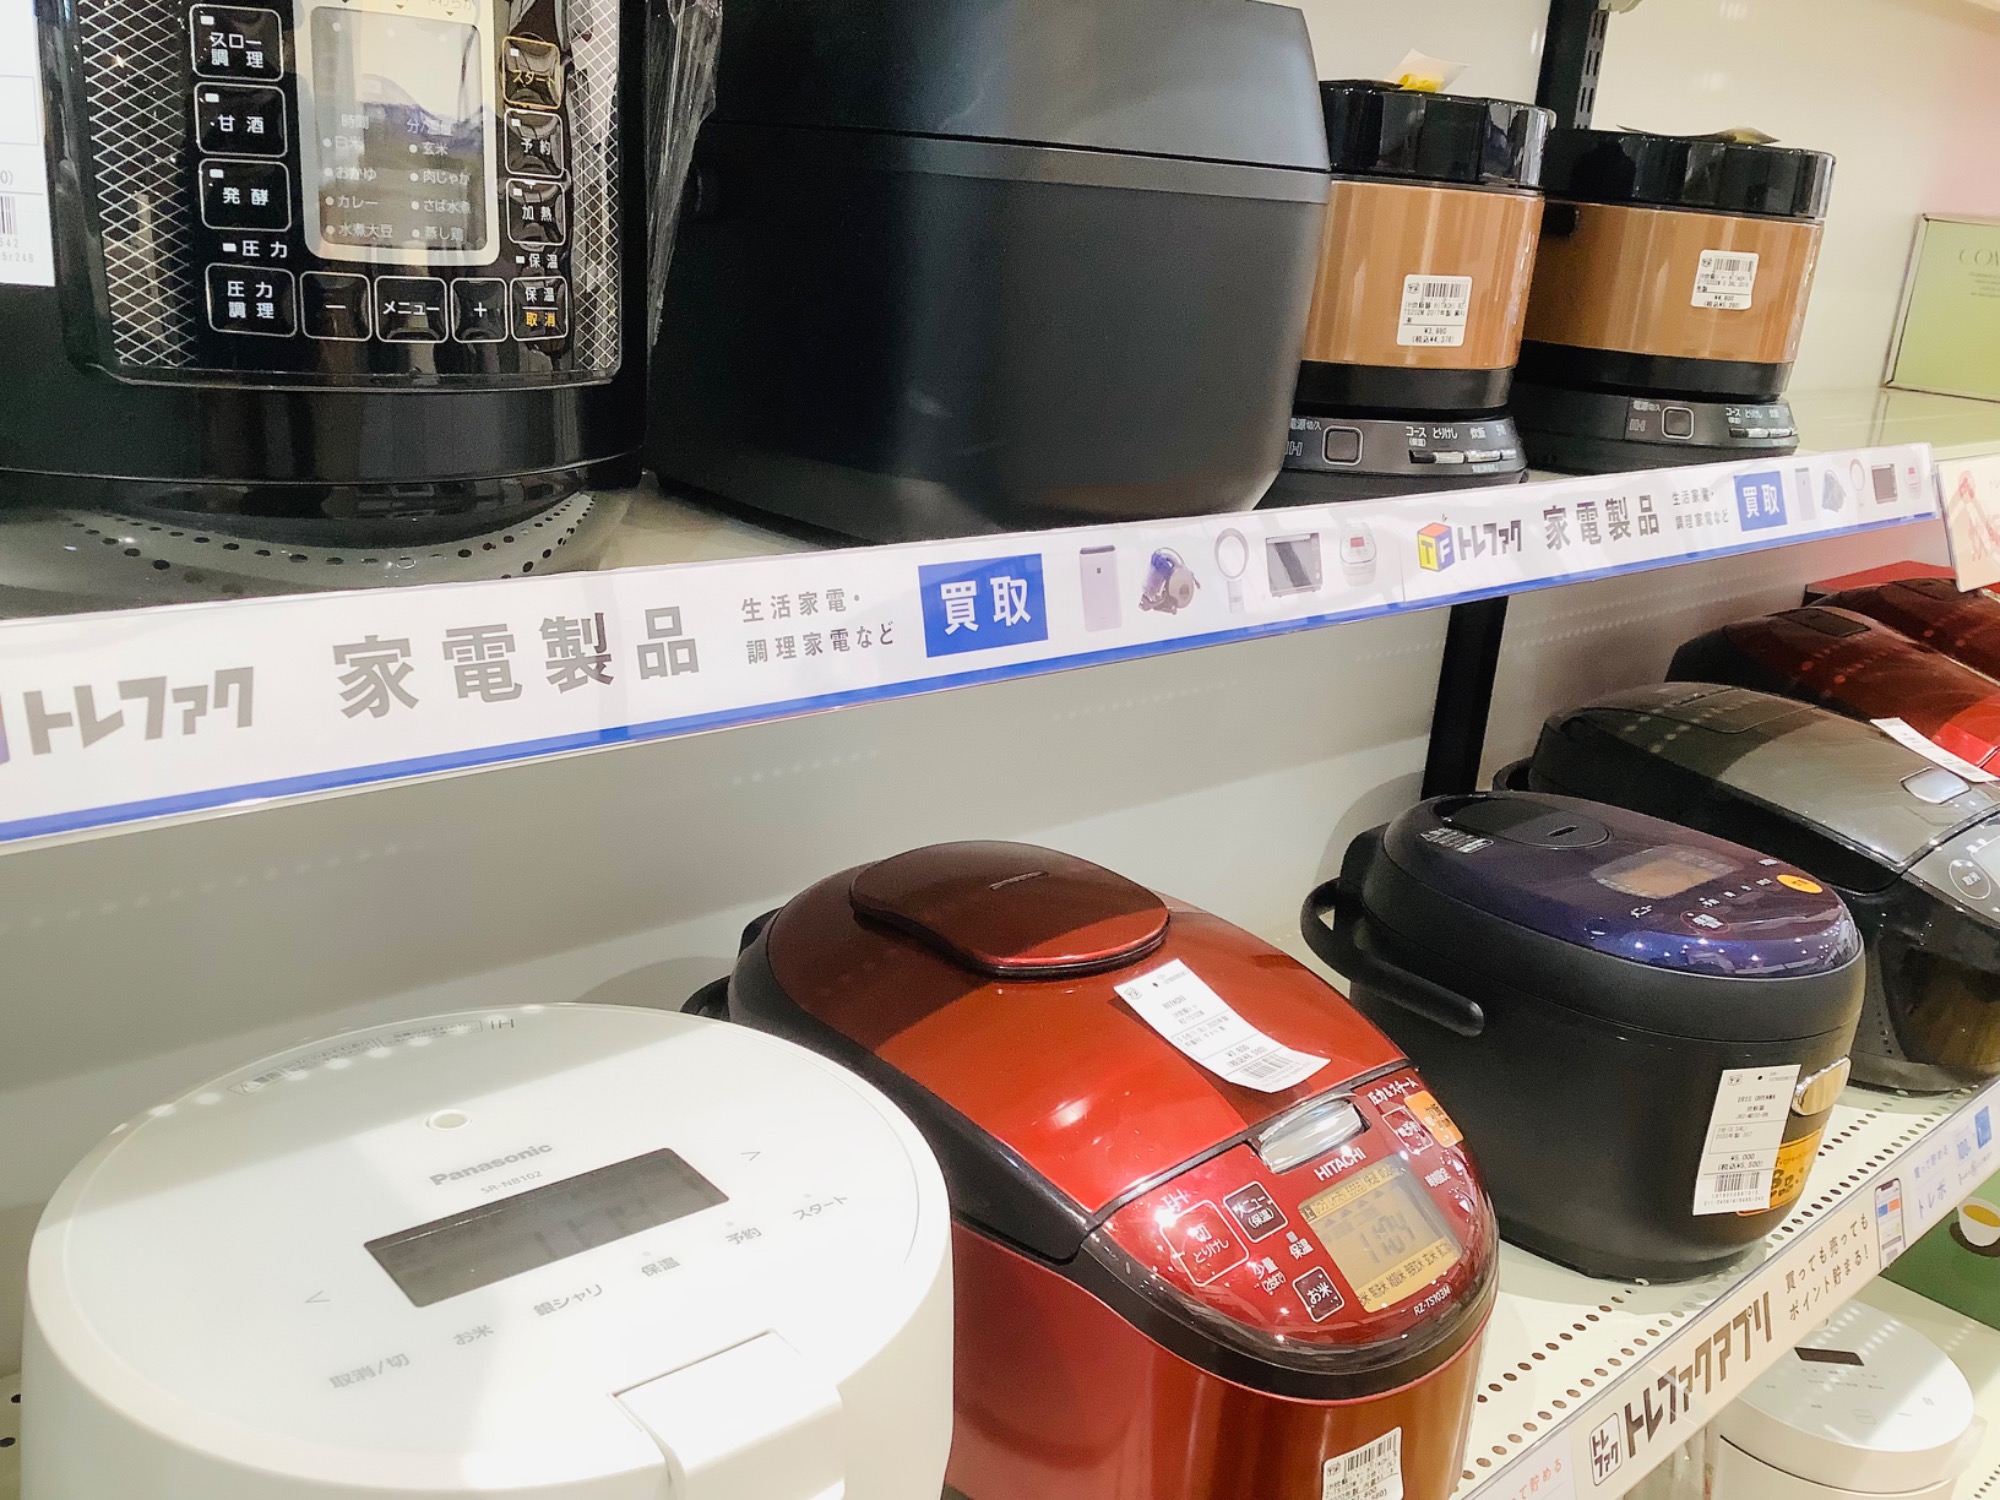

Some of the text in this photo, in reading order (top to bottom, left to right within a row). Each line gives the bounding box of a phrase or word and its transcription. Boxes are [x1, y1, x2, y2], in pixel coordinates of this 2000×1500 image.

[210, 31, 262, 49] スロー
[211, 49, 264, 69] 調理
[512, 70, 556, 87] スタート
[217, 115, 265, 135] 甘酒
[422, 141, 449, 156] 玄米
[521, 138, 552, 155] 予約
[423, 170, 471, 186] 肉じゃが
[222, 186, 271, 207] 発酵
[338, 195, 379, 209] カレー
[521, 205, 552, 221] 加熱
[338, 222, 393, 239] 水煮大豆
[424, 226, 465, 242] 蒸し鶏
[242, 239, 288, 259] 圧力
[528, 252, 559, 270] 保温
[227, 280, 274, 299] 圧力
[525, 286, 555, 302] 保温
[228, 301, 275, 320] 調理
[382, 299, 441, 316] メニュー
[526, 311, 556, 328] 取消
[1406, 426, 1427, 438] コース
[1741, 482, 1781, 519] 買取
[1543, 494, 1661, 551] 家電製品
[1457, 519, 1523, 561] トレファク
[939, 573, 1034, 637] 買取
[745, 618, 895, 665] 調理家電など
[331, 604, 701, 720] 家電製品
[23, 666, 255, 756] トレファク
[429, 1143, 554, 1186] Panasonic
[1313, 1147, 1367, 1183] HITACHI
[480, 1171, 544, 1194] SR-NB102
[792, 1194, 849, 1221] スタート
[1248, 1207, 1274, 1229] (保温)
[725, 1226, 763, 1246] 予約
[1193, 1238, 1229, 1263] とりけし
[1288, 1238, 1314, 1260] 保温
[1785, 1212, 1869, 1294] 買っても売っても
[640, 1256, 681, 1278] 保温
[533, 1283, 603, 1317] 銀シャリ
[1307, 1282, 1333, 1305] お米
[453, 1323, 495, 1346] お米
[328, 1352, 411, 1390] 取消/切
[1623, 1291, 1772, 1459] トレファクアプリ
